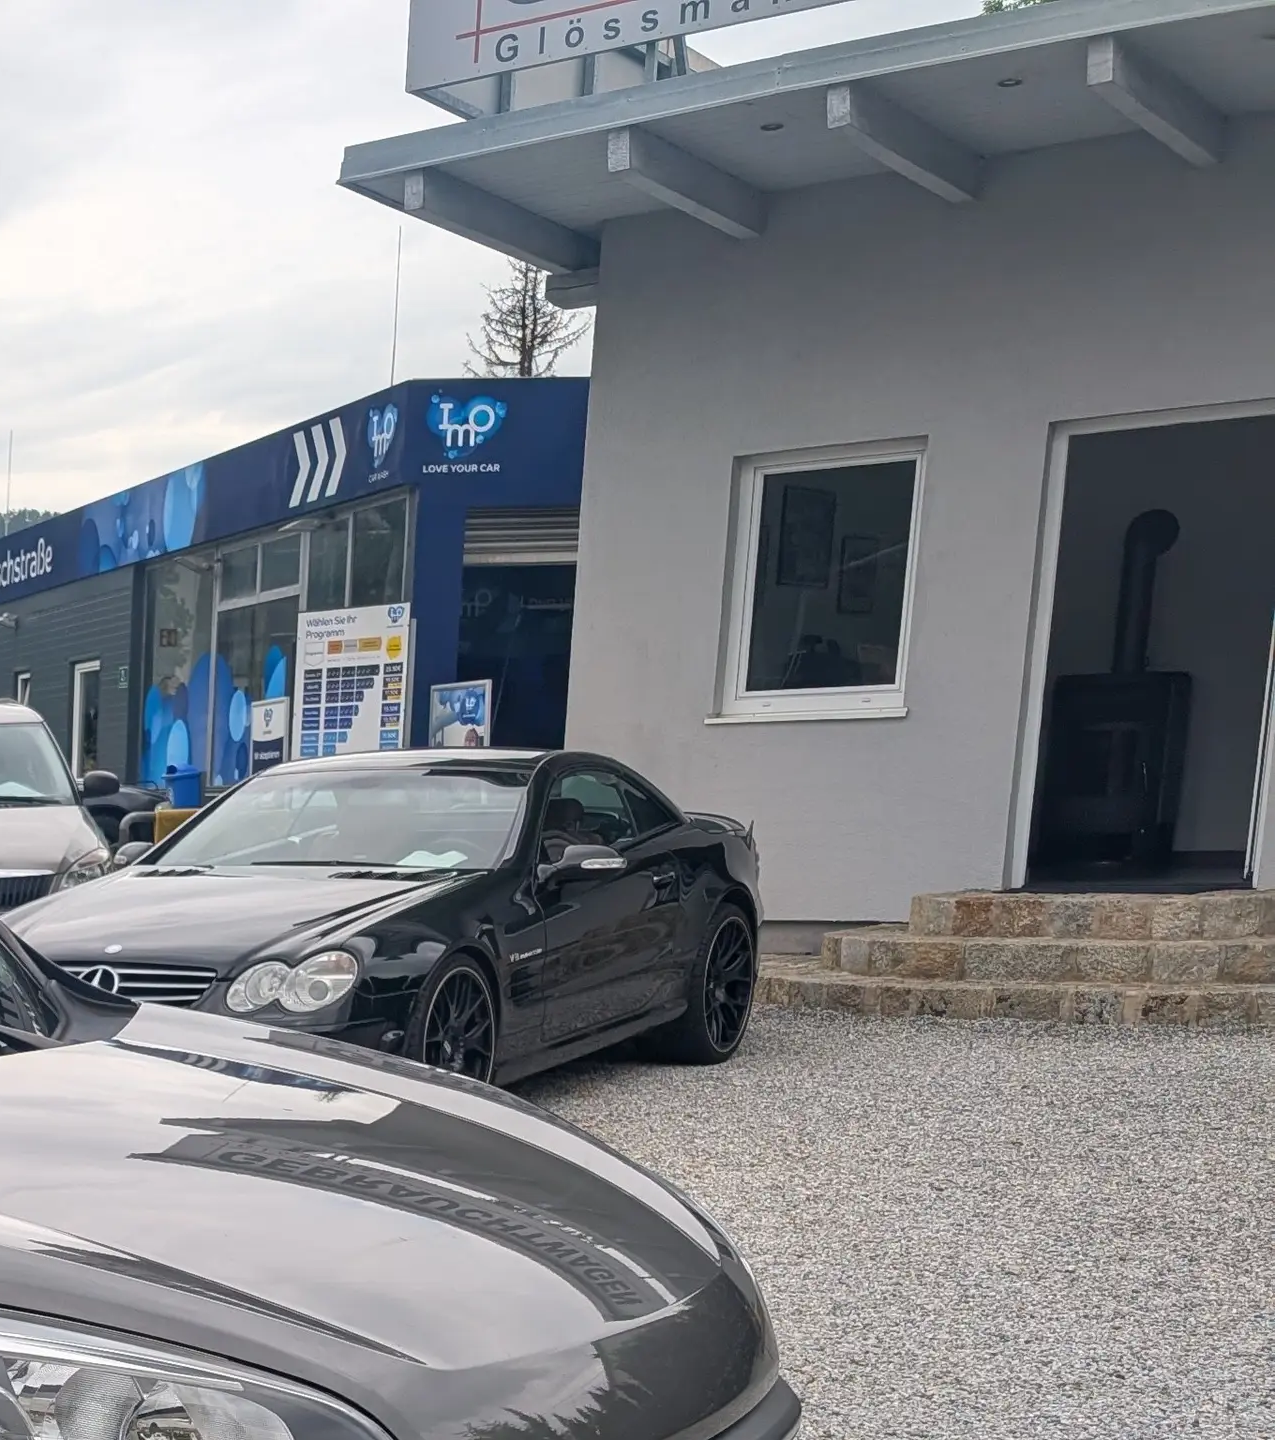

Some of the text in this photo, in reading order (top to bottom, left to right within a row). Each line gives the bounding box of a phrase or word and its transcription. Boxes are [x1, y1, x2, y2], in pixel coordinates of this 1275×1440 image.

[495, 0, 791, 63] Glössma
[422, 463, 500, 473] LOVE YOUR CAR
[306, 615, 357, 628] Wählen Sie Ihr
[306, 629, 345, 640] Programm
